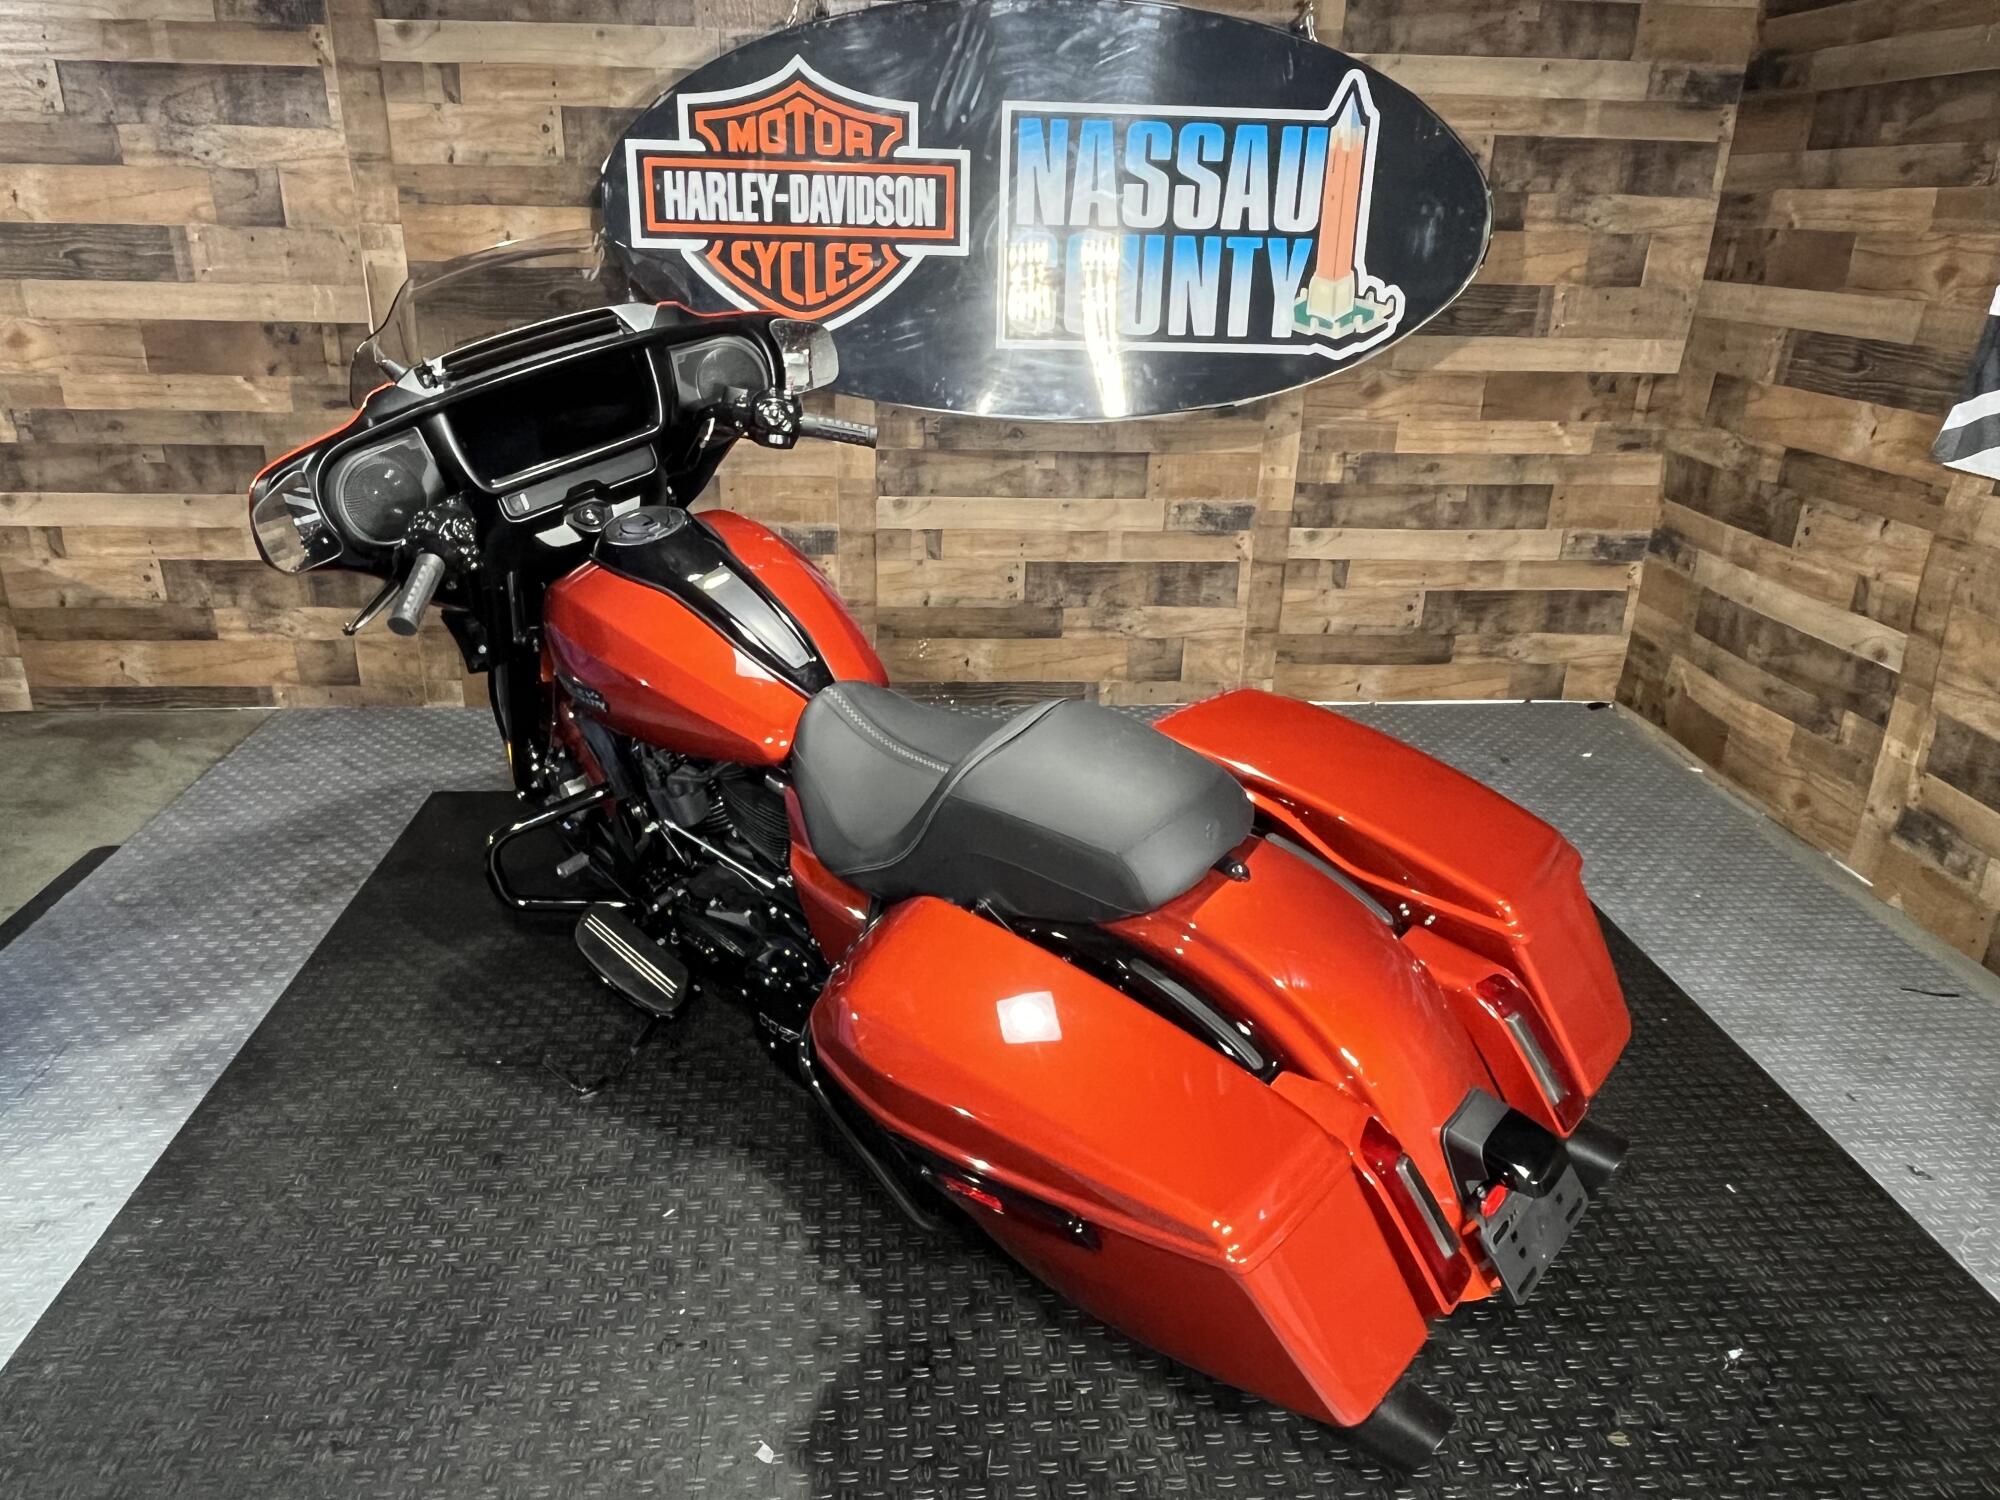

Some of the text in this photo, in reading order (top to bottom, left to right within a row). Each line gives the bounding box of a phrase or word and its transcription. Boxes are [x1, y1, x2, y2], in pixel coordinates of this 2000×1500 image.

[727, 97, 873, 157] MOTOR
[663, 170, 936, 227] HARLEY-DAVIDSON
[1016, 117, 1328, 232] NASSAU
[731, 240, 874, 305] CYCLES
